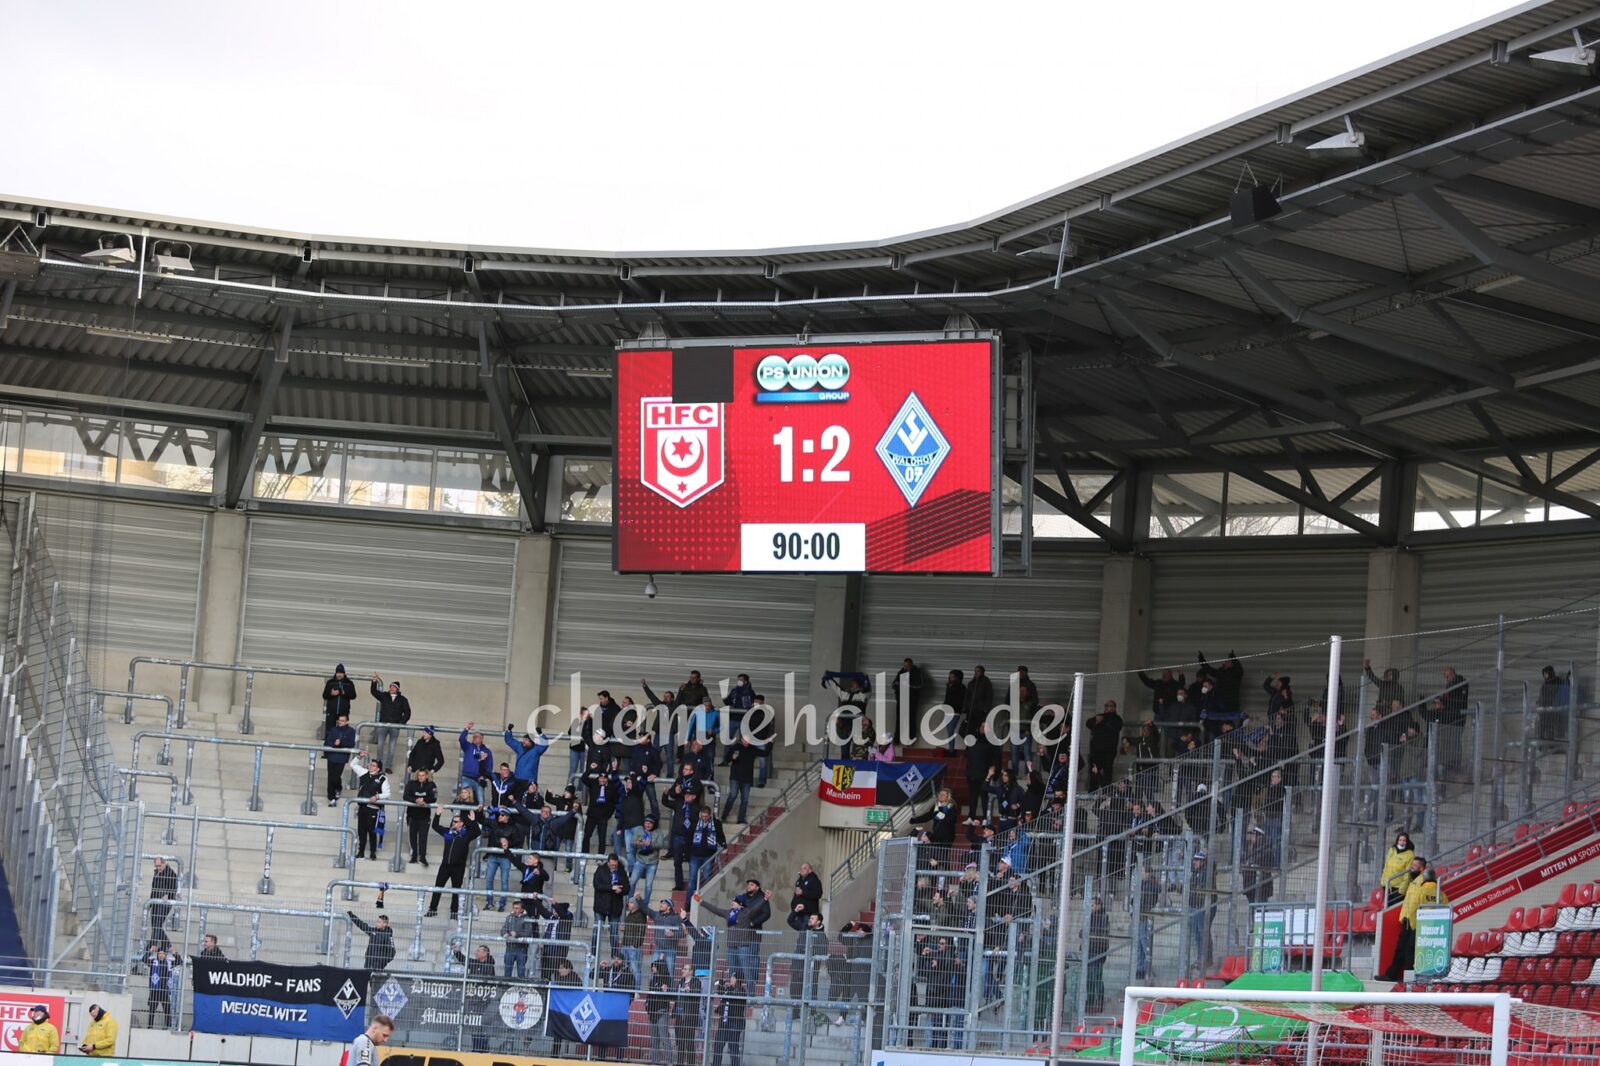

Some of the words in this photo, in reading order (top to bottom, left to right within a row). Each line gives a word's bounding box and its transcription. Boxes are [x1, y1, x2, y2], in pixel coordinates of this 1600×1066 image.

[762, 366, 785, 379] PS
[789, 365, 844, 378] UNION
[818, 391, 850, 400] GROUP
[651, 404, 715, 426] HFC
[773, 424, 851, 483] 1:2
[904, 466, 924, 483] 07
[772, 531, 841, 561] 90:00
[1540, 859, 1568, 878] MITTEN
[1567, 855, 1578, 865] IM
[1577, 843, 1600, 861] SPORT
[208, 970, 272, 988] WALDHOF
[286, 977, 322, 993] FANS
[221, 1000, 308, 1023] MEUSELWITZ
[420, 1007, 482, 1026] Mannheim
